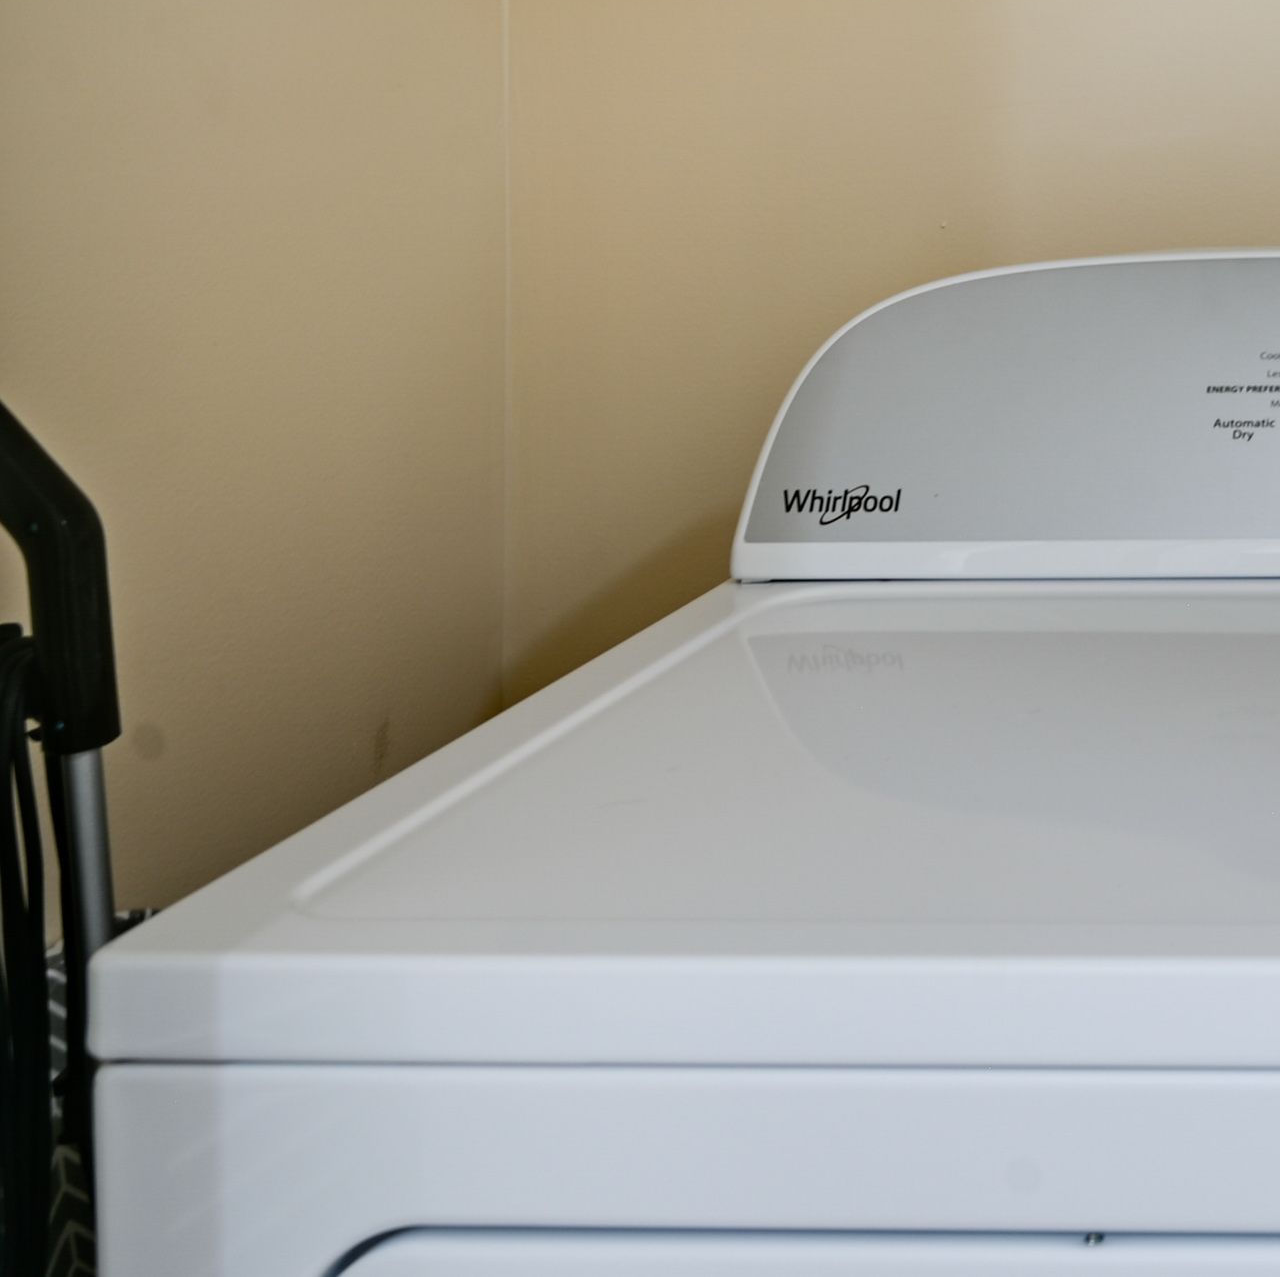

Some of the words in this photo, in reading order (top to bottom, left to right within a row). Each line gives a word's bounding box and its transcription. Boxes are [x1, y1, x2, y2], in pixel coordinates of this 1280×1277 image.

[1206, 385, 1244, 393] ENERGY
[1213, 418, 1276, 428] Automatic
[1232, 429, 1254, 442] Dry
[783, 485, 901, 525] Whirlpool
